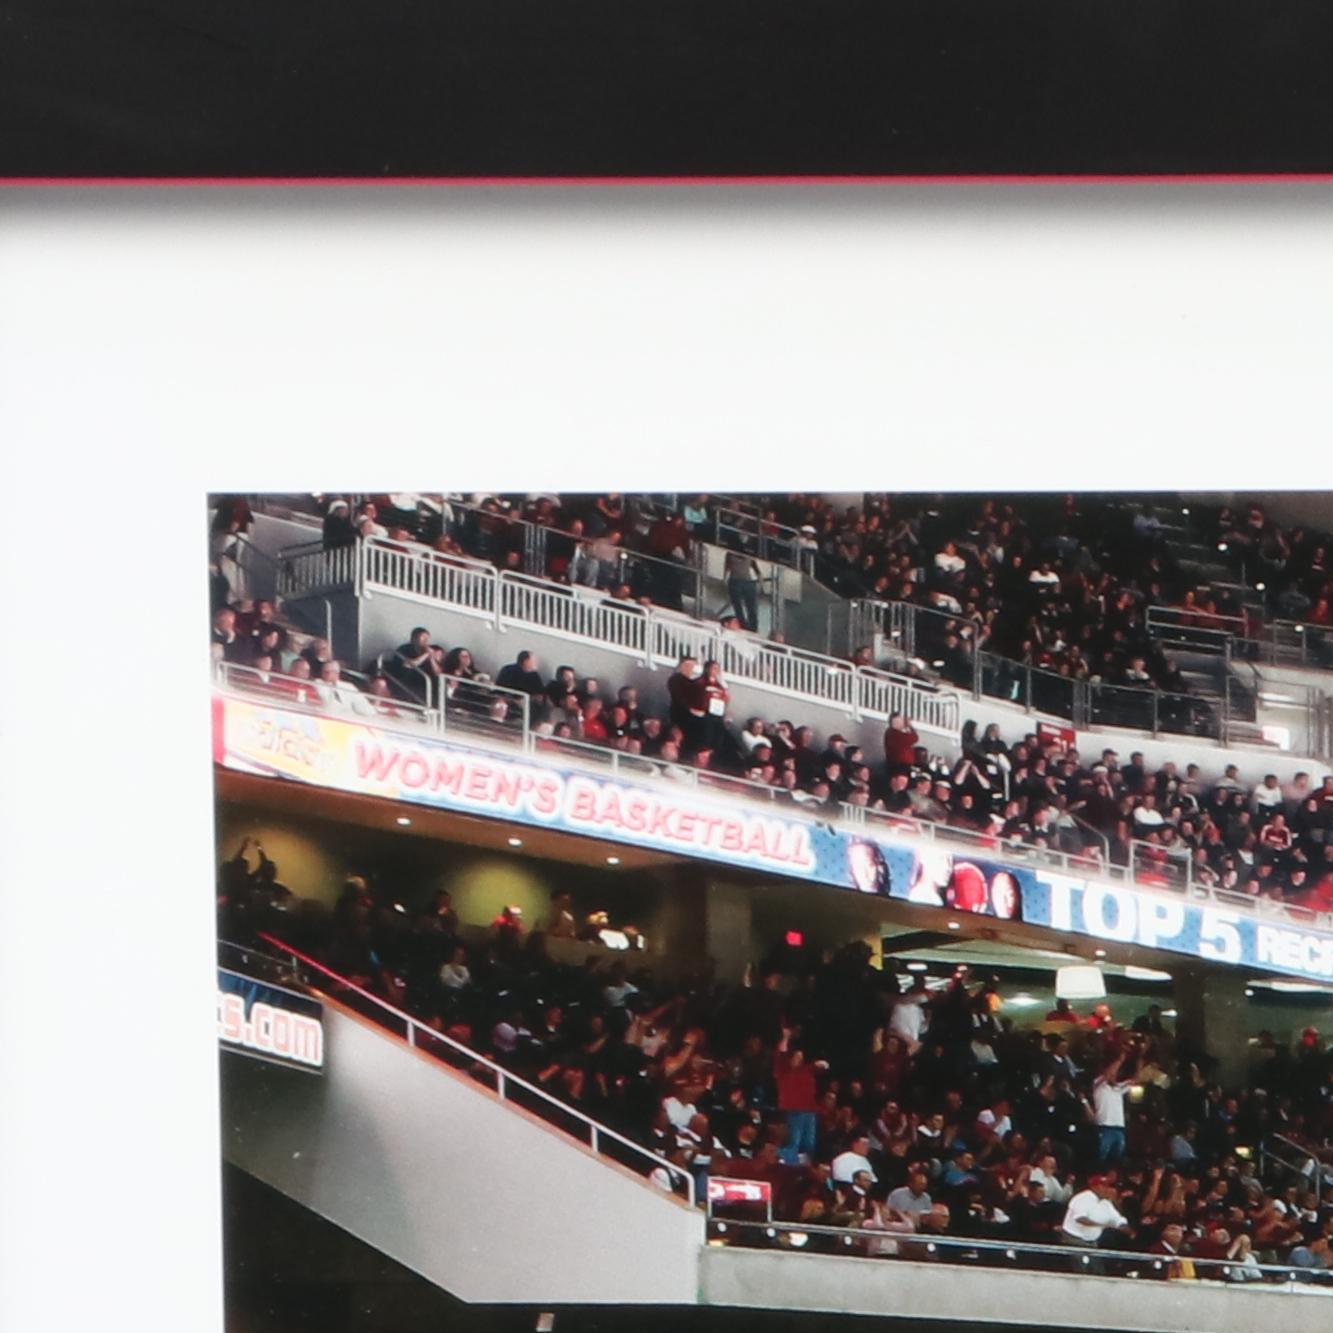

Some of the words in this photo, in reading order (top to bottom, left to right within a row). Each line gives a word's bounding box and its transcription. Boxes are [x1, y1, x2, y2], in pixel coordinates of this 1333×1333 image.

[353, 740, 561, 815] WOMEN'S
[568, 778, 812, 867] BASKETBALL
[1036, 869, 1186, 948] TOP
[1197, 907, 1243, 965] 5
